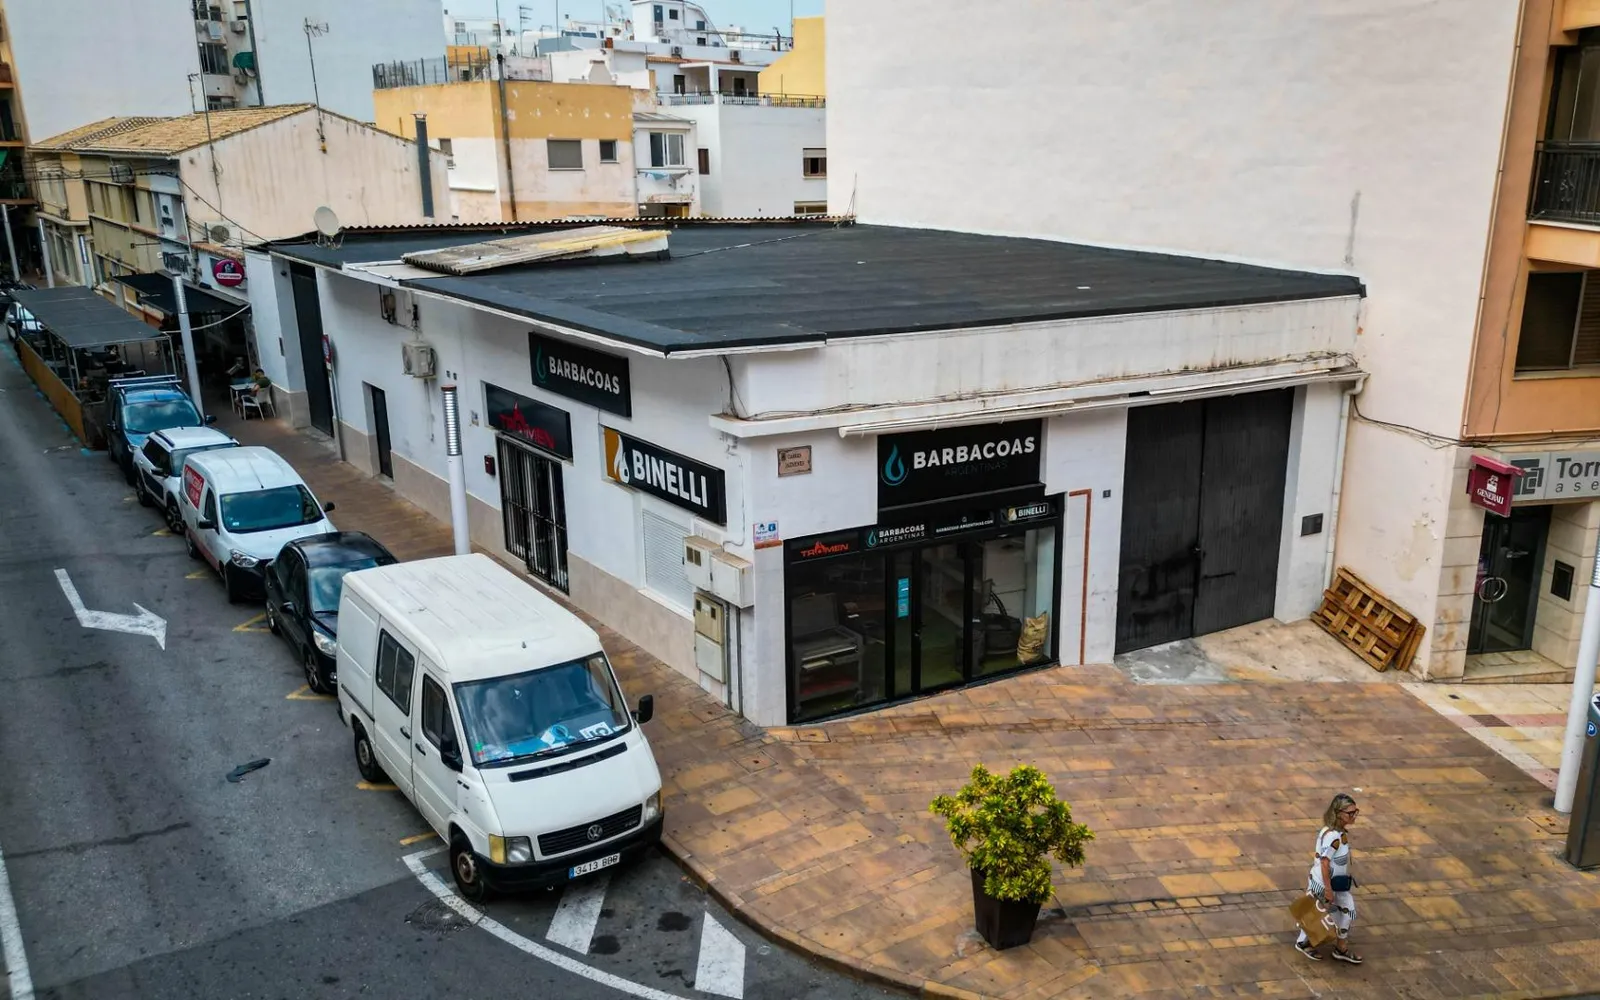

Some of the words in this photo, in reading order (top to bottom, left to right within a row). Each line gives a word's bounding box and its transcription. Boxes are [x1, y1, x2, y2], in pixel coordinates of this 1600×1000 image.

[549, 355, 620, 394] BARBACOAS
[913, 436, 1035, 469] BARBACOAS
[945, 461, 1008, 477] ARGENTINAS
[631, 449, 708, 508] BINELLI
[1477, 488, 1504, 505] GENERALI
[1018, 506, 1046, 518] BINELLI
[879, 524, 925, 538] BARBACOAS
[879, 531, 925, 544] ARGENTINAS
[575, 861, 599, 875] 3413
